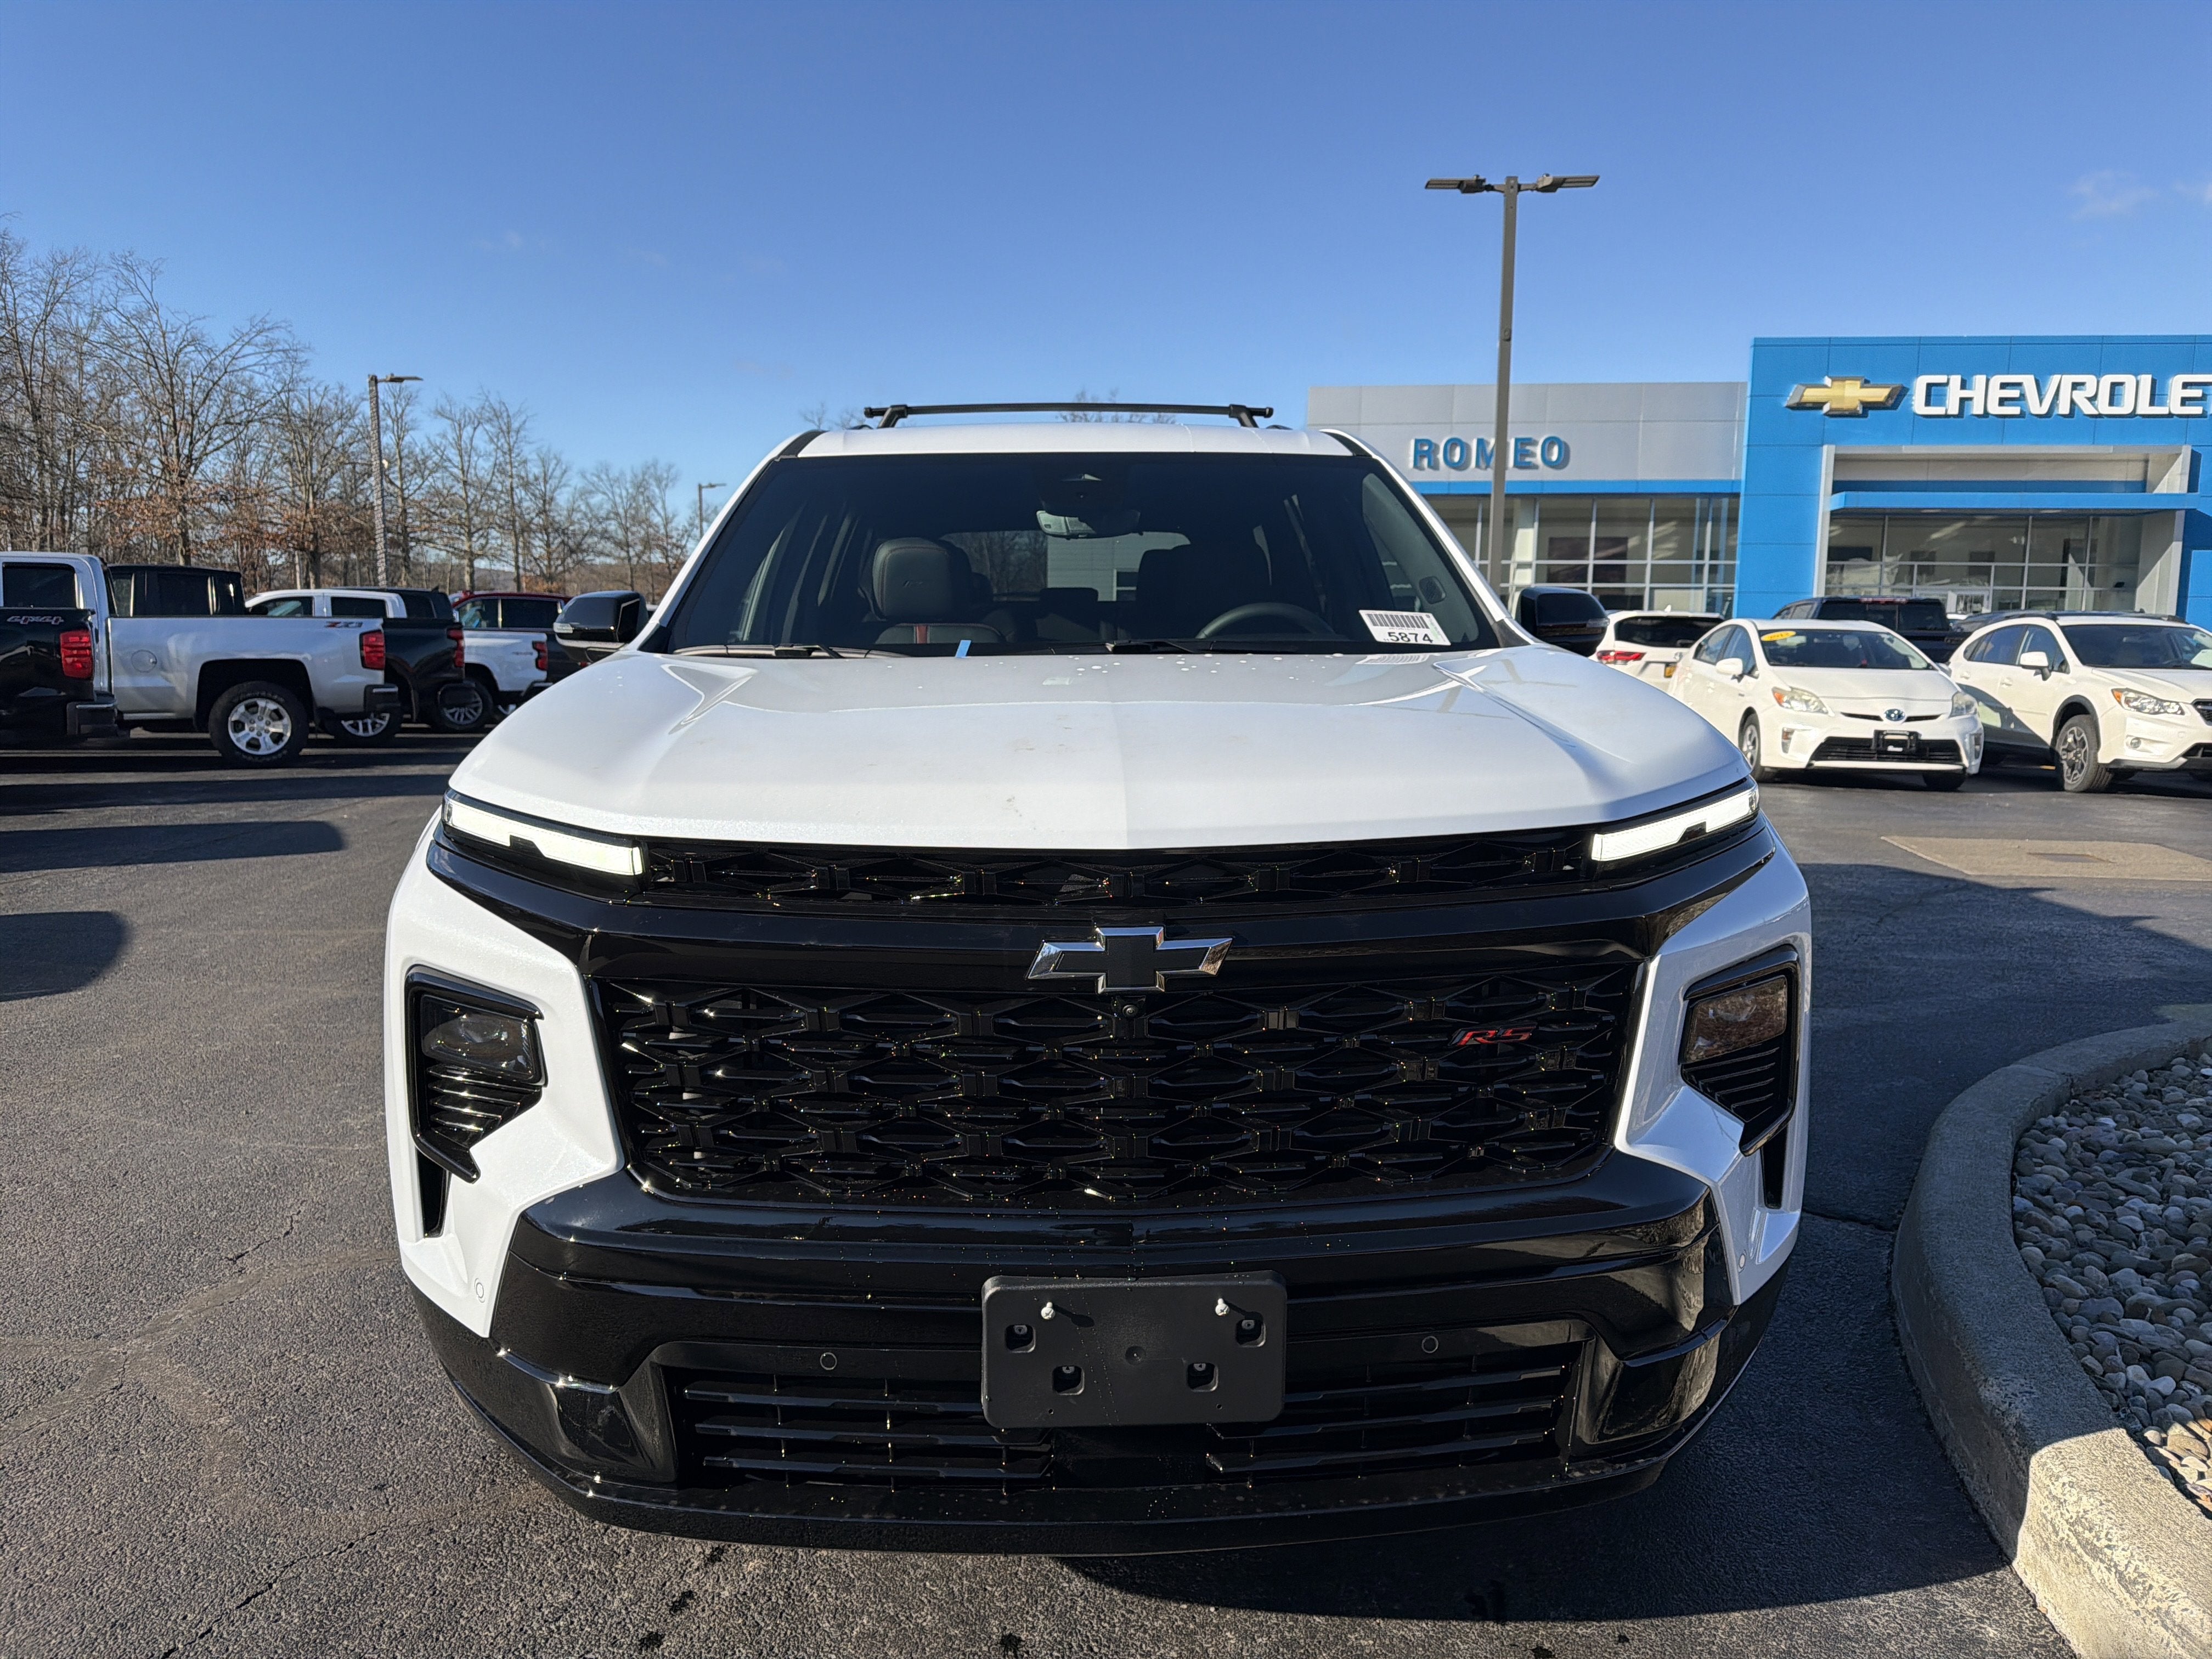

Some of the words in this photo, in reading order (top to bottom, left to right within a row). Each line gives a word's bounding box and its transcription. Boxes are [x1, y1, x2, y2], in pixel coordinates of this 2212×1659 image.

[1914, 374, 2212, 415] CHEVROLE
[1412, 436, 1567, 469] ROMEO
[1387, 631, 1434, 643] 5874
[1451, 1024, 1537, 1047] RS
